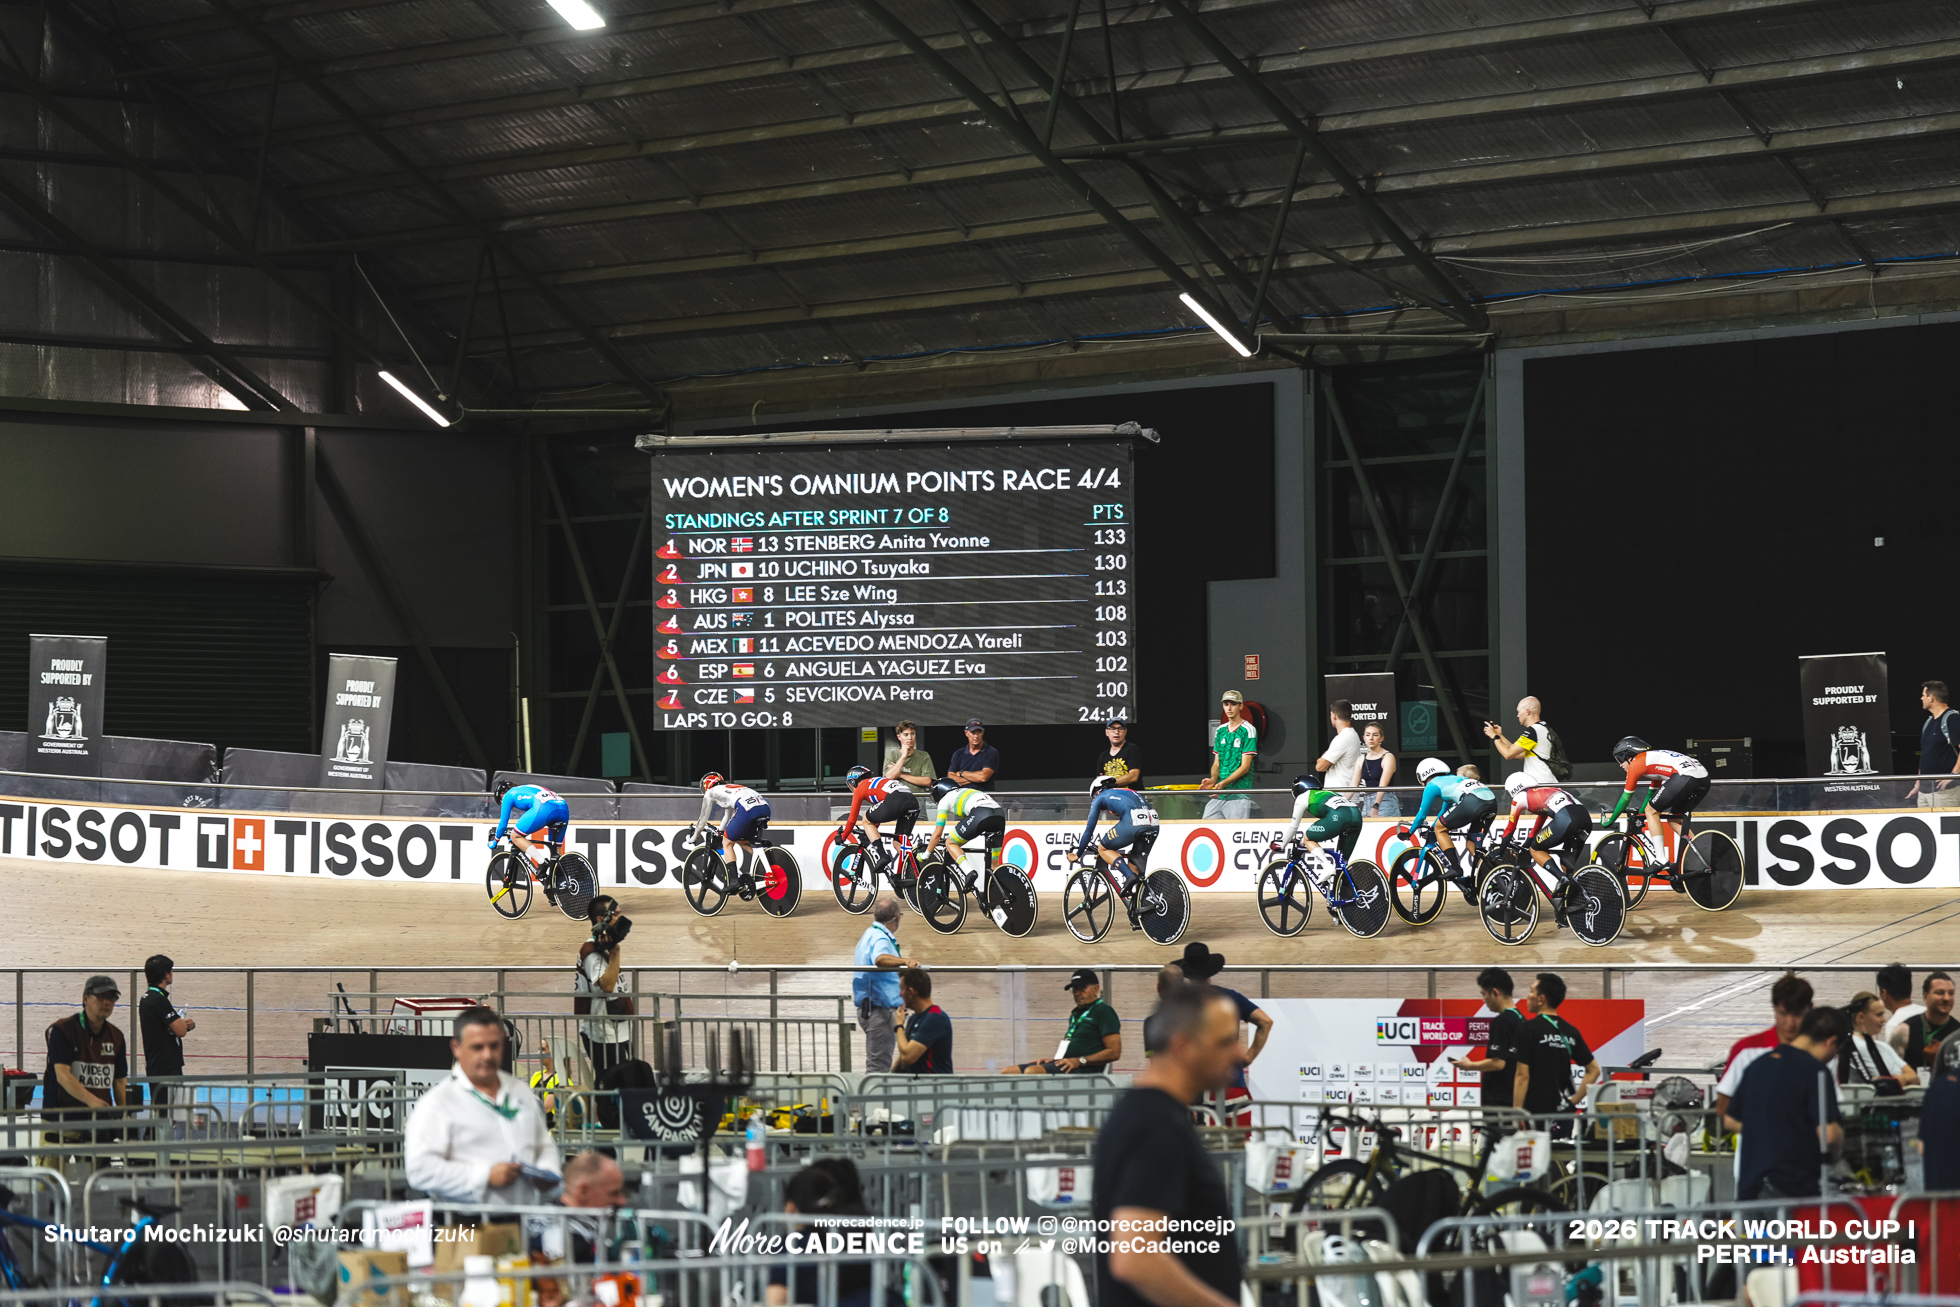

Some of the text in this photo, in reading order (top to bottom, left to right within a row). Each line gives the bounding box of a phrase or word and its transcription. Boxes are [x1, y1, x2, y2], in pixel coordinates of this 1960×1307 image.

[662, 468, 1122, 498] WOMEN'S OMNIUM POINTS RACE 4/4
[665, 507, 950, 529] STANDINGS AFTER SPRINT 7 OF 8
[1093, 503, 1124, 519] PTS
[666, 529, 1126, 554] 1 NOR 13 STENBERG Anita Yvonne 133
[666, 554, 1127, 580] 2 JPN 10 UCHINO Tsuyaka 130
[666, 580, 1127, 605] 3 HKG 8 LEE Sze Wing 113
[666, 605, 1127, 629] 4 AUS 1 POLITES Alyssa 108
[666, 631, 1127, 655] 5 MEX 11 ACEVEDO MENDOZA Yareli 103
[51, 659, 83, 672] PROUDLY
[667, 656, 1127, 680] 6 ESP 6 ANGUELA YAGUEZ Eva 102
[40, 672, 93, 686] SUPPORTED BY
[345, 680, 375, 694] PROUDLY
[667, 681, 1128, 704] 7 CZE 5 SEVCIKOVA Petra 100
[1824, 685, 1864, 695] PROUDLY
[335, 693, 381, 708] SUPPORTED BY
[1351, 703, 1377, 711] ROUDLY
[1812, 694, 1877, 706] SUPPORTED BY
[664, 711, 793, 728] LAPS TO GO: 8
[1078, 706, 1128, 722] 24:14
[1377, 712, 1388, 720] BY
[0, 804, 181, 866] TISSOT
[1232, 831, 1270, 843] GLEN
[274, 820, 473, 879] TISSOT
[1007, 866, 1035, 909] BLACK INC
[1384, 1022, 1416, 1040] UCI
[1422, 1022, 1445, 1031] TRACK
[1468, 1022, 1490, 1031] PERTH
[1422, 1032, 1463, 1040] WORLD CUP
[1468, 1032, 1490, 1041] AUSTR
[81, 1063, 111, 1076] VIDEO
[1303, 1067, 1320, 1076] UCI
[1407, 1067, 1424, 1077] UCI
[78, 1075, 112, 1087] RADIO
[341, 1079, 396, 1119] UC
[1329, 1091, 1346, 1100] UCI
[1433, 1091, 1452, 1101] UCI
